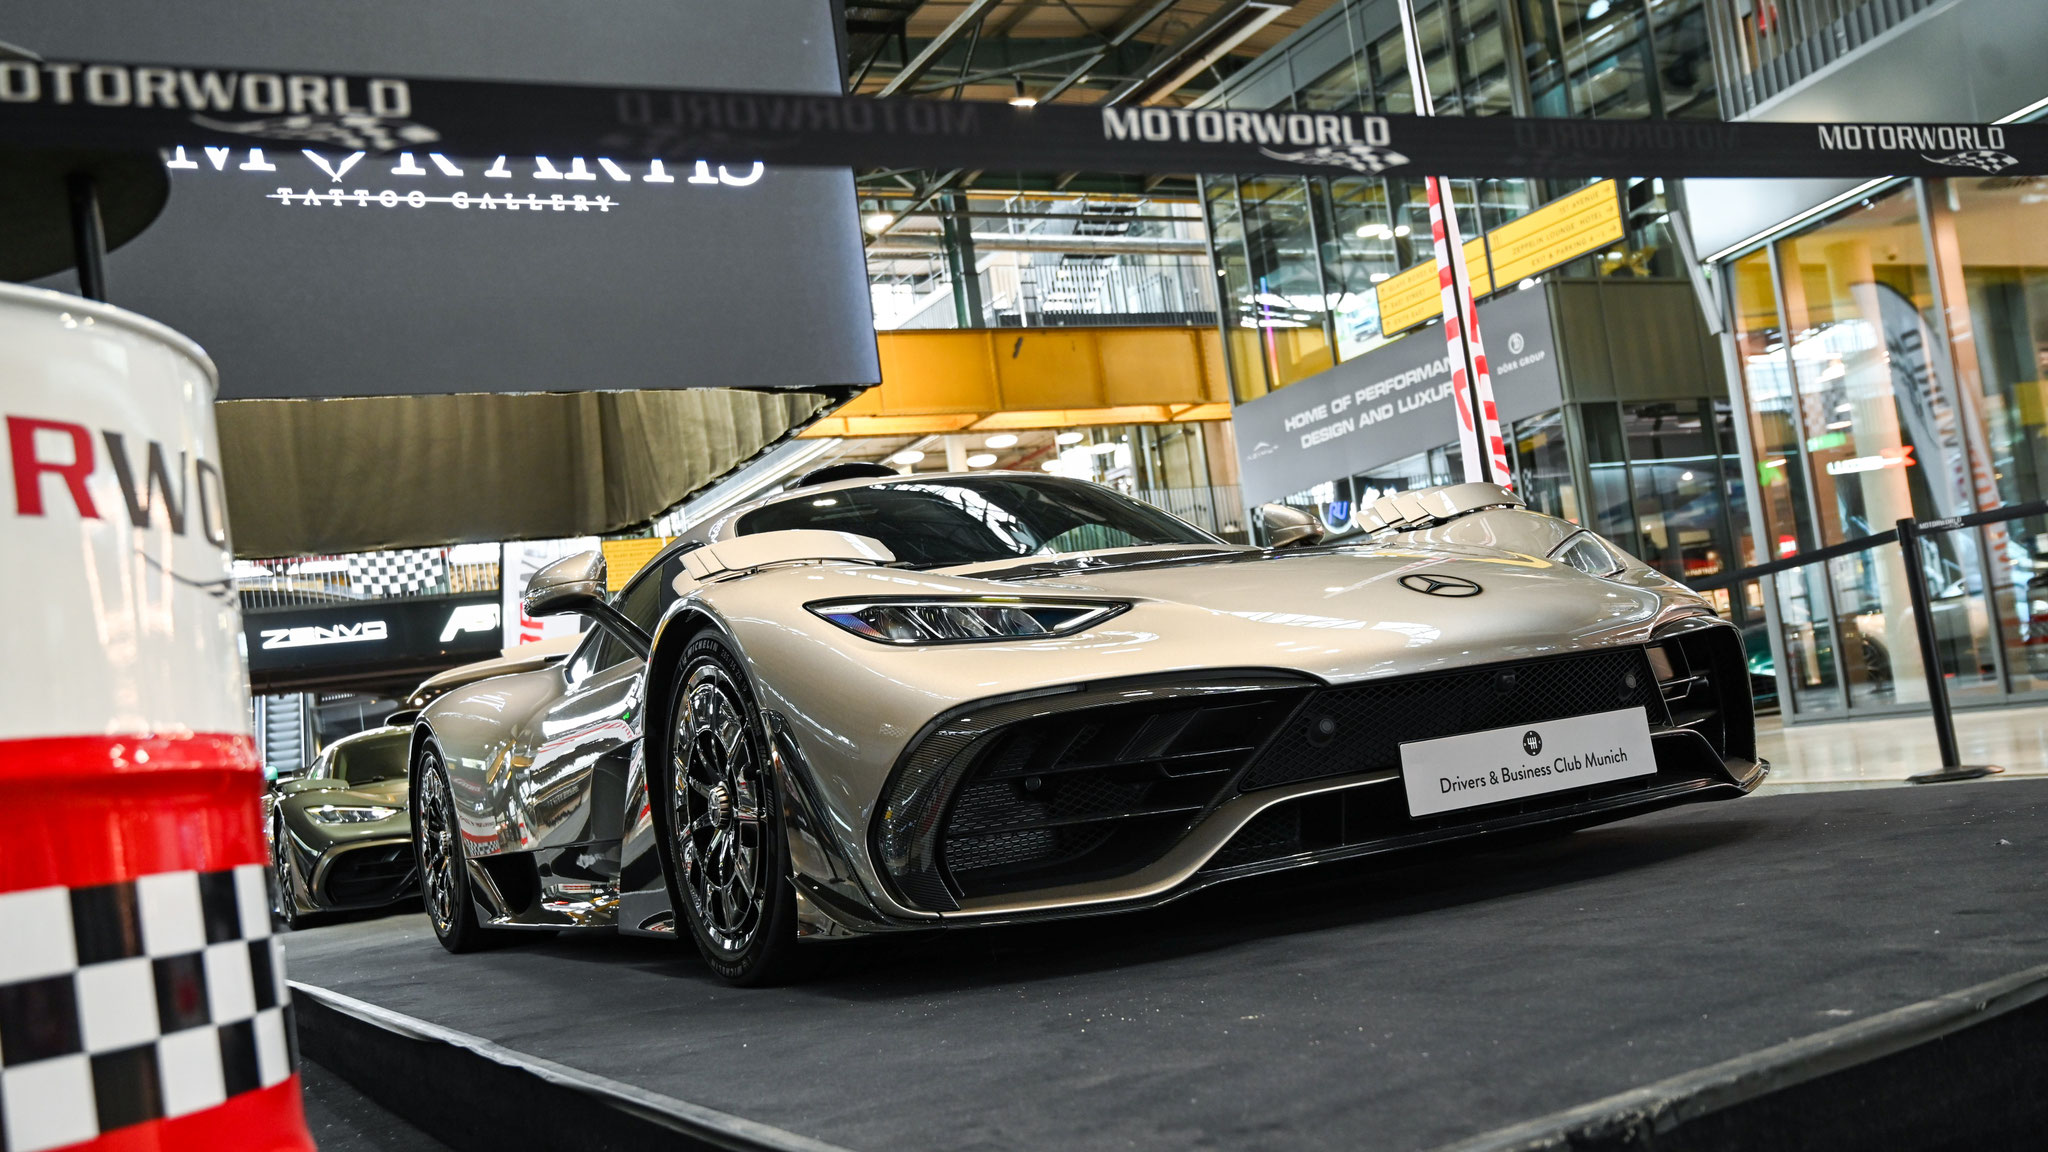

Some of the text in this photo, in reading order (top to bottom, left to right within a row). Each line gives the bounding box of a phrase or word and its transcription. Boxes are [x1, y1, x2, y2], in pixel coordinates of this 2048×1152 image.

[1102, 107, 1392, 146] MOTORWORLD
[1818, 125, 2005, 151] MOTORWORLD
[277, 187, 611, 212] TATTOO GALLERY
[1496, 349, 1546, 376] DÖRR GROUP
[1284, 404, 1328, 432] HOME
[1331, 394, 1352, 415] OF
[1301, 418, 1355, 449] DESIGN
[1359, 403, 1394, 428] AND
[260, 619, 388, 650] ZENVO
[687, 639, 719, 658] MICHELIN
[1439, 747, 1628, 794] Drivers & Business Club Munich
